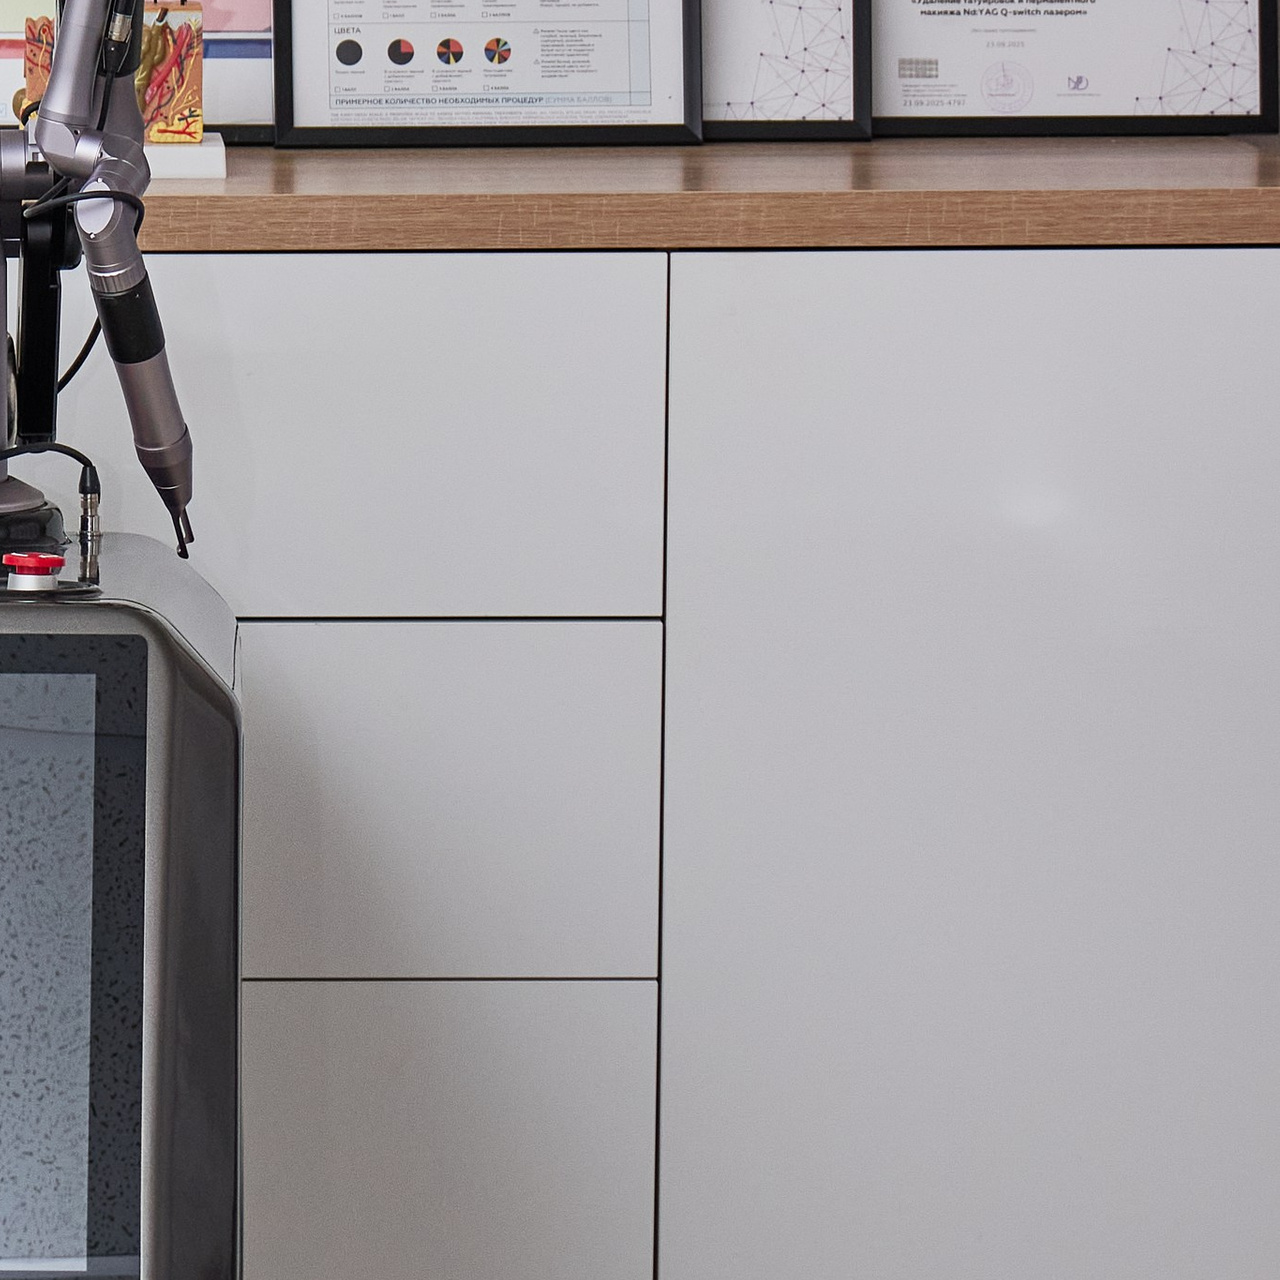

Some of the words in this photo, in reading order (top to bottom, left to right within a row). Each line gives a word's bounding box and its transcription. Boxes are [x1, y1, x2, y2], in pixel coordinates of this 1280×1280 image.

[920, 9, 962, 17] макияжа
[1000, 8, 1041, 18] Q-switch
[334, 26, 362, 36] ЦВЕТА
[335, 98, 384, 107] ПРИМЕРНОЕ
[385, 97, 437, 106] КОЛИЧЕСТВО
[438, 96, 500, 106] НЕОБХОДИМЫХ
[501, 96, 545, 106] ПРОЦЕДУР
